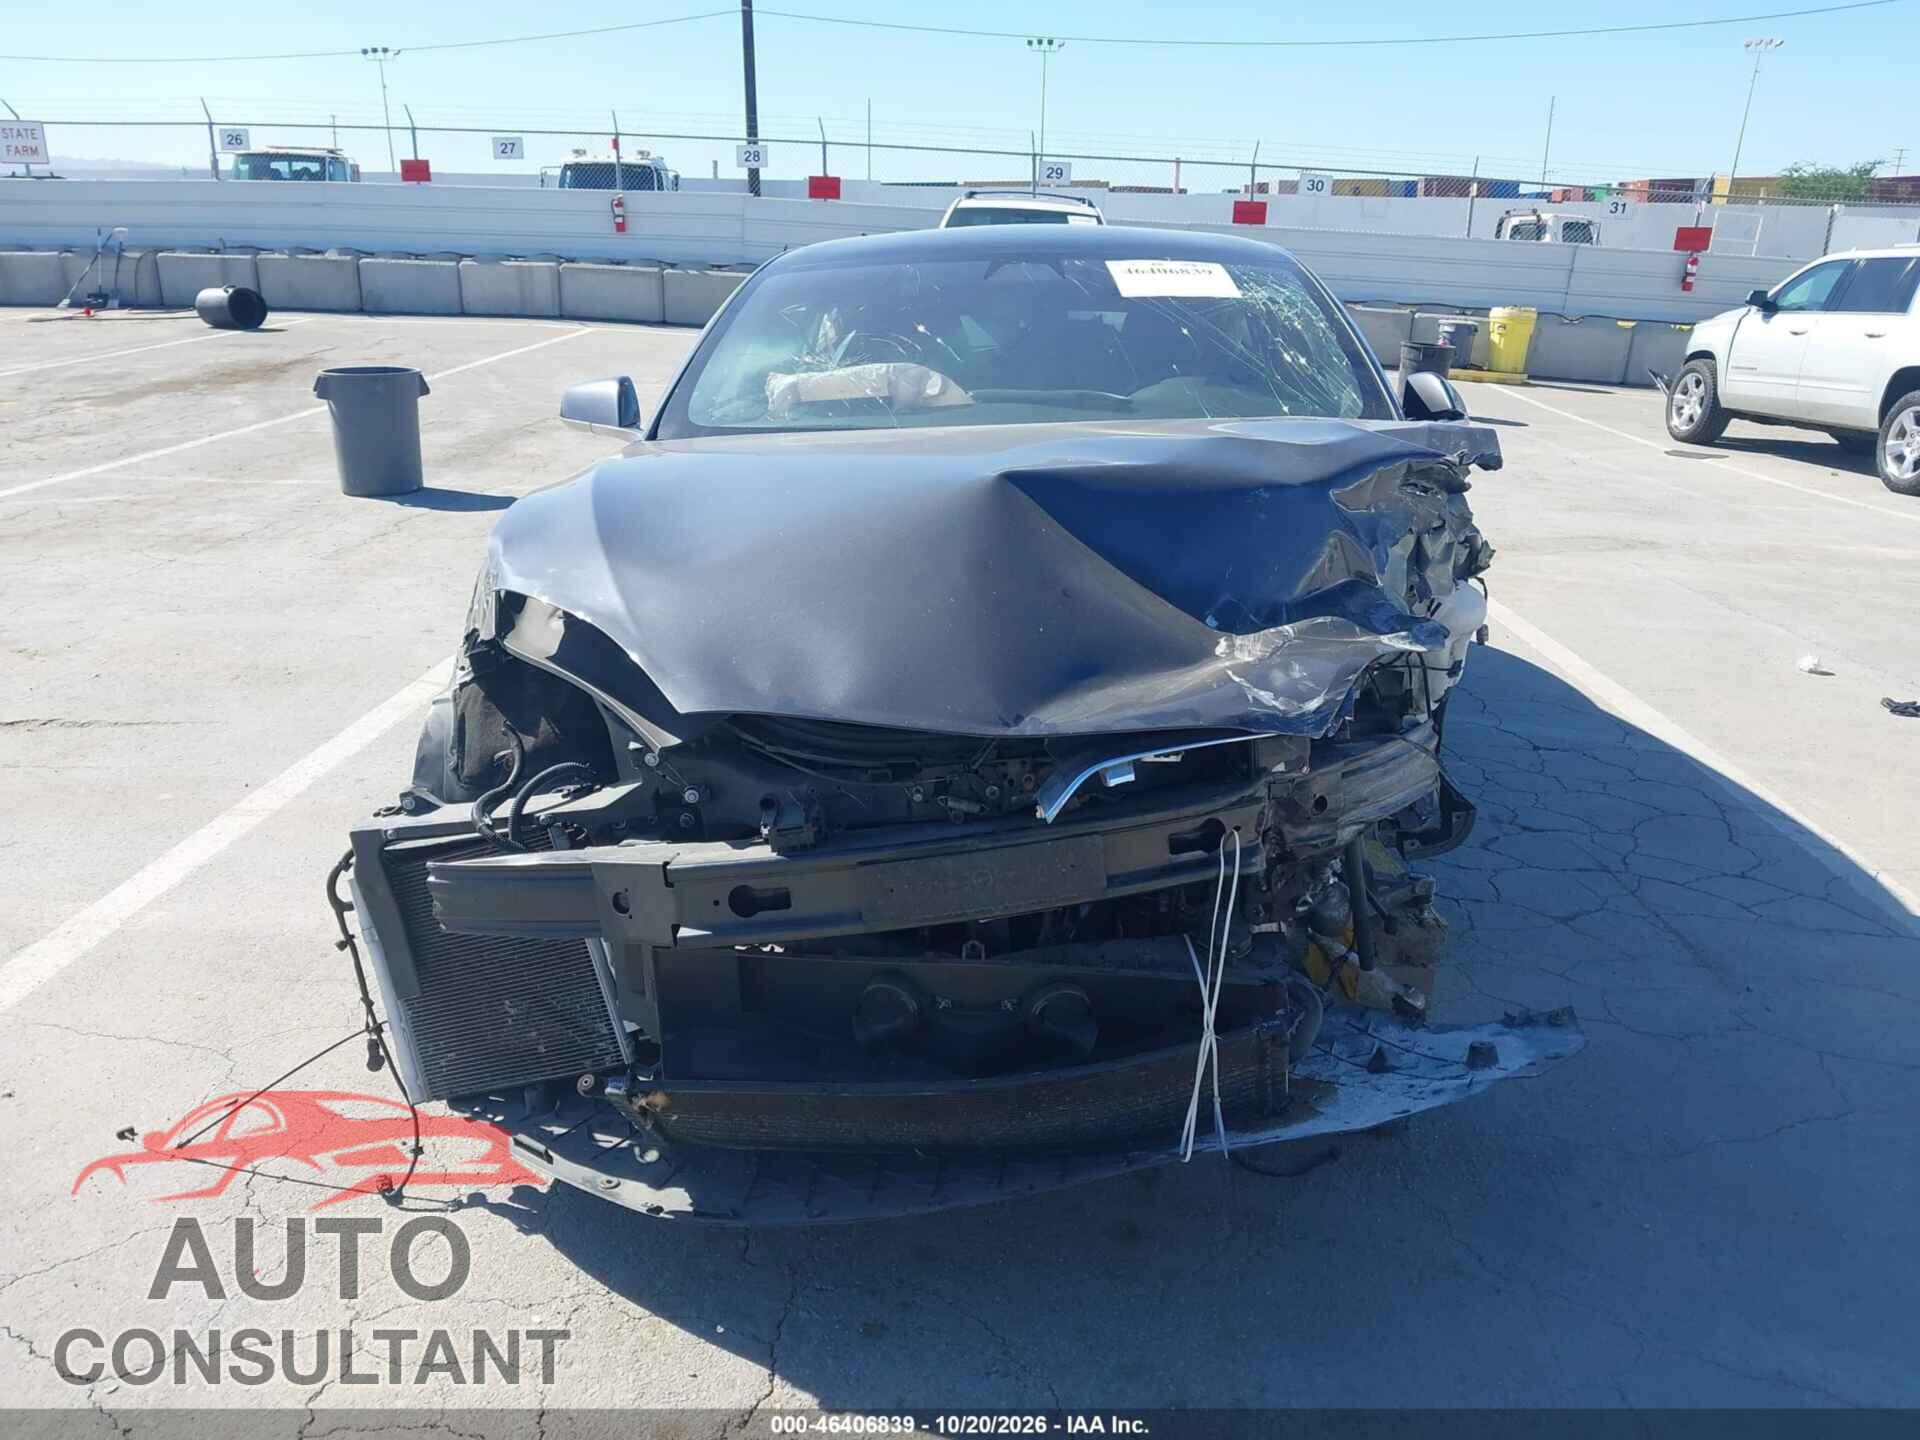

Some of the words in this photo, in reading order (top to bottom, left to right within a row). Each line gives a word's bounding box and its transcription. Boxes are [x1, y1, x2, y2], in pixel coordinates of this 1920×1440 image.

[1, 127, 38, 140] STATE
[226, 134, 243, 146] 26
[5, 144, 39, 156] FARM
[500, 142, 516, 154] 27
[743, 150, 761, 162] 28
[1046, 166, 1064, 180] 29
[1306, 179, 1325, 192] 30
[1609, 202, 1627, 214] 31
